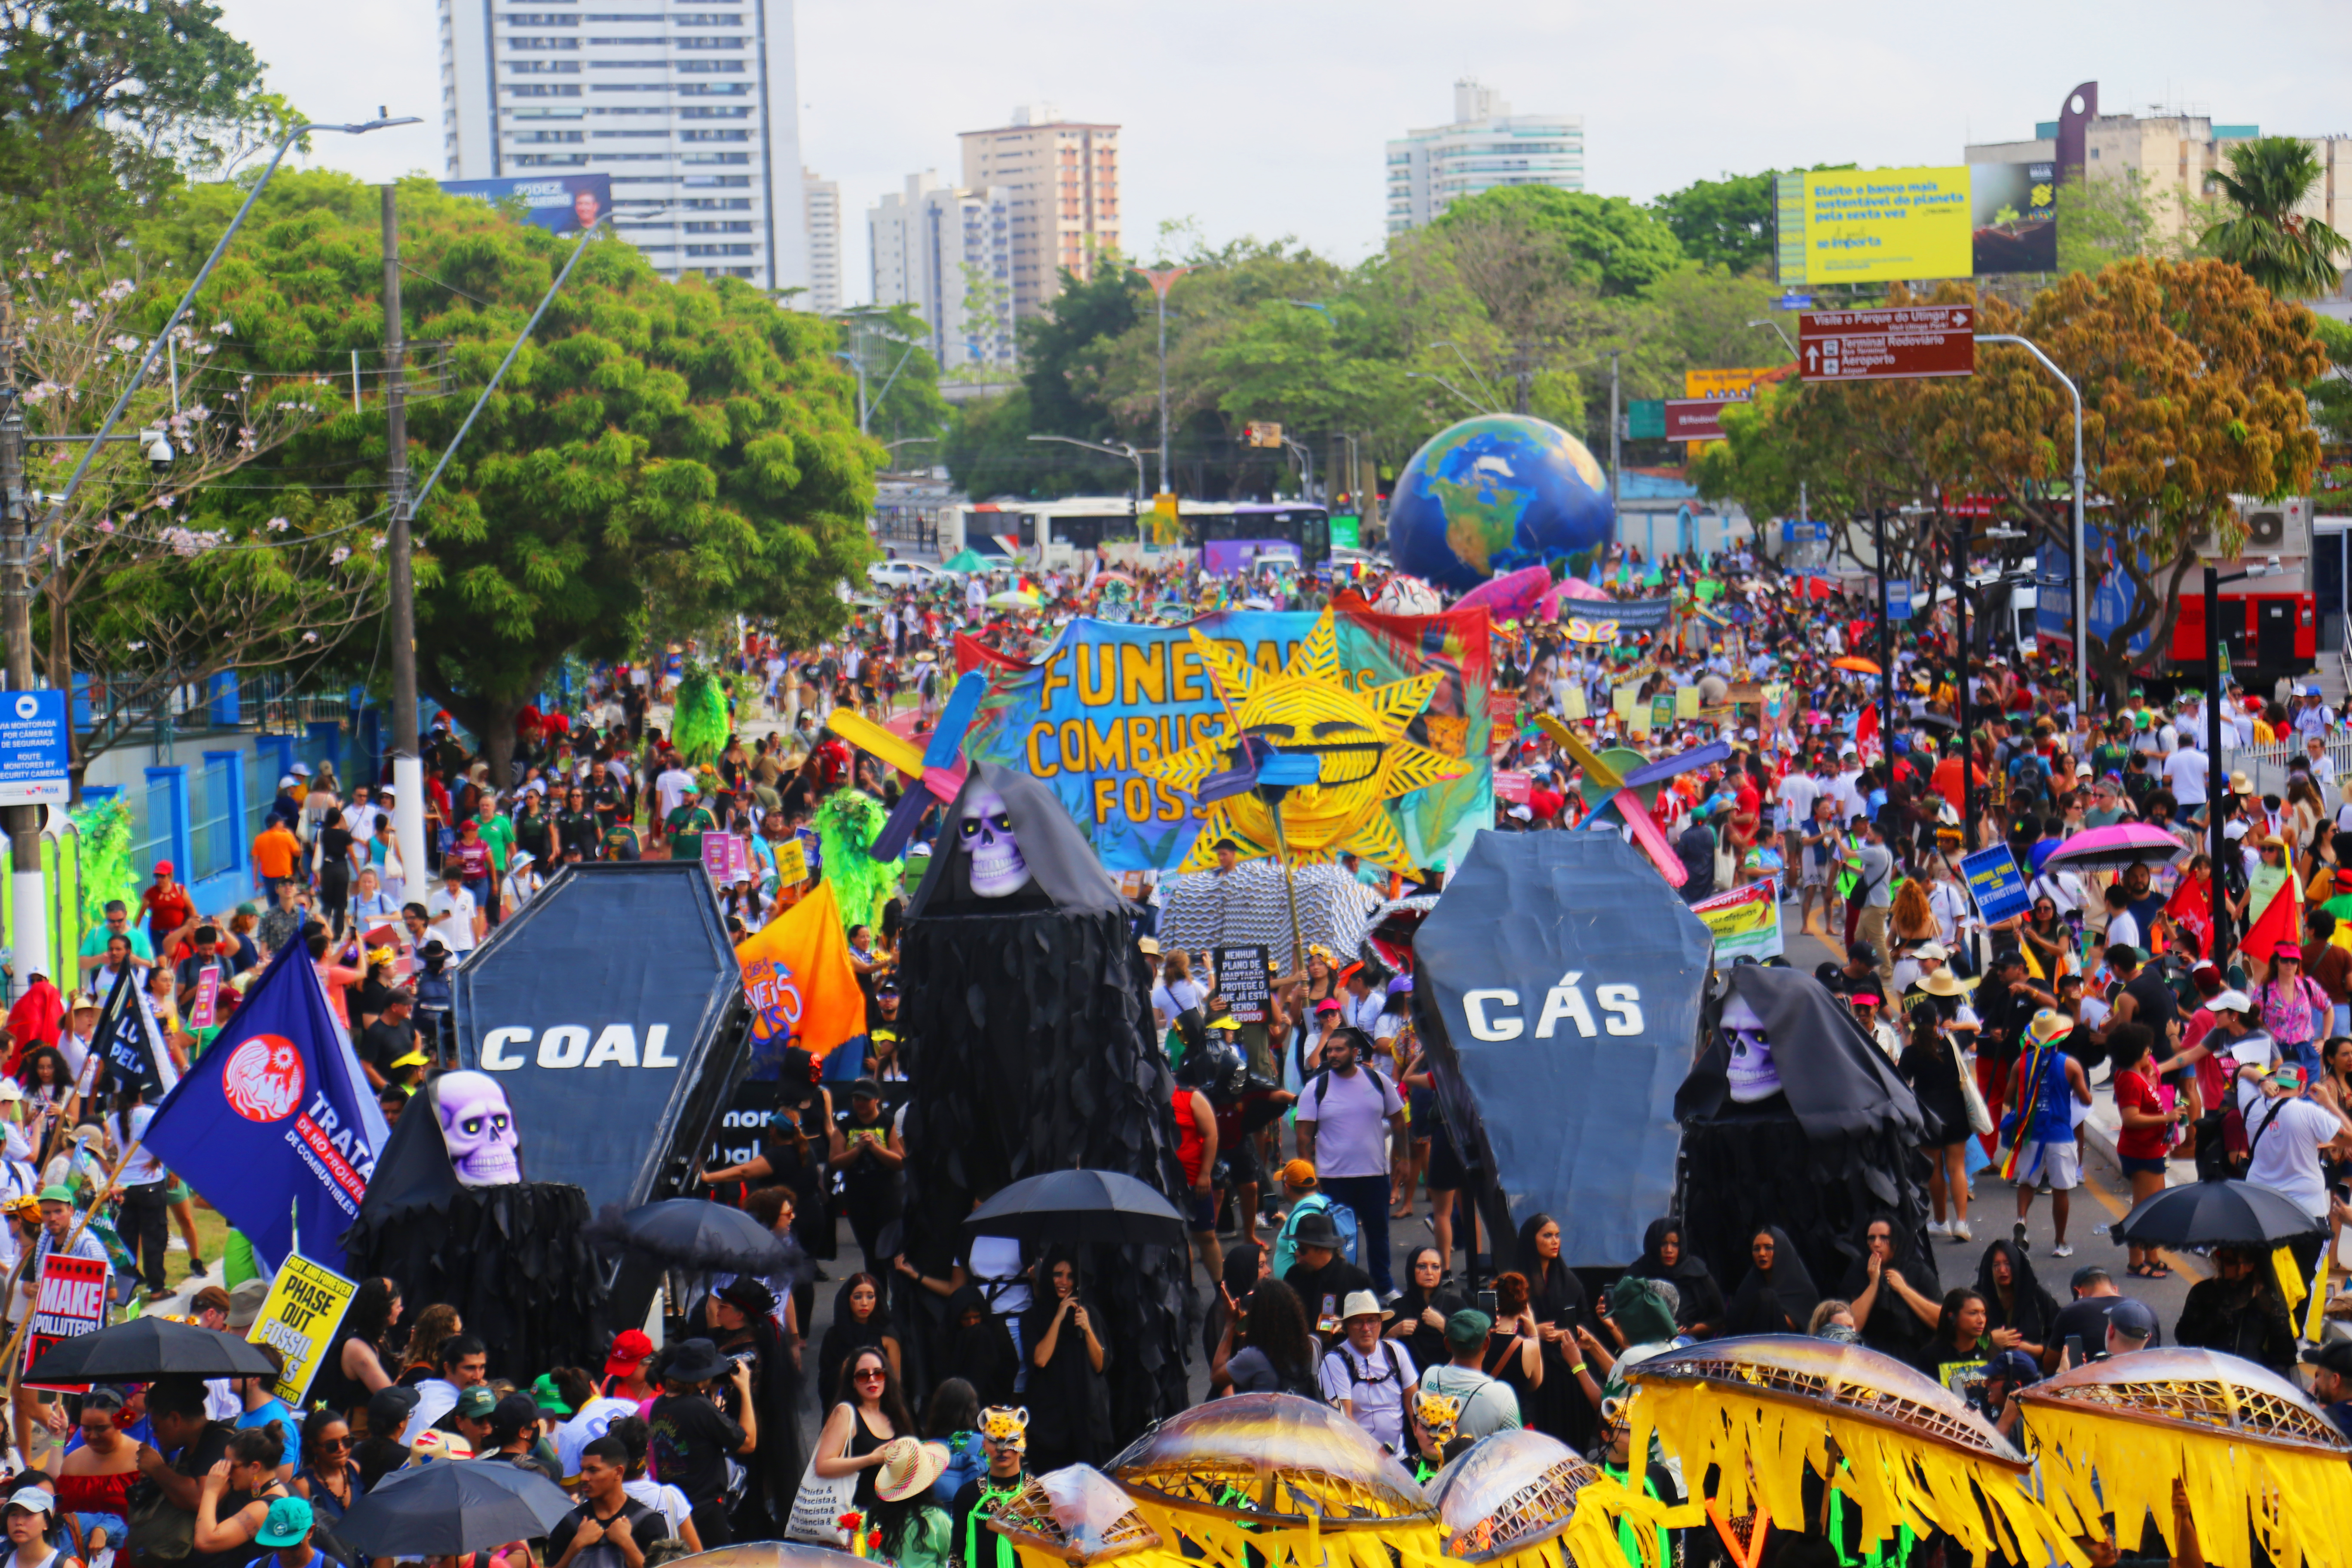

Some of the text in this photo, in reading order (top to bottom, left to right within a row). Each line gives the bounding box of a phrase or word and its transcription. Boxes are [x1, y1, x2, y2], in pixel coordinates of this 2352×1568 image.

[1815, 181, 1938, 197] Eleito o banco mais
[1816, 193, 1964, 209] sustentável do planeta
[1815, 209, 1906, 224] pela sexta vez
[1817, 236, 1881, 250] se importa
[1813, 309, 1949, 326] Visite o Parque do Utinga!
[1841, 334, 1945, 348] Terminal Rodoviário
[1841, 354, 1895, 367] Aeroporto
[11, 720, 56, 729] MONITORADA
[19, 730, 53, 738] CÂMERAS
[12, 738, 55, 748] SEGURANÇA
[3, 761, 44, 770] MONITORED
[0, 769, 64, 780] ECURITY CAMERAS
[1969, 861, 2015, 887] FOSSIL FREE
[1978, 882, 2023, 907] EXTINCTION
[1224, 950, 1257, 960] NENHUM
[1222, 960, 1261, 971] PLANO DE
[1220, 969, 1265, 981] ADAPTAÇÃO
[1221, 980, 1265, 992] PROTEGE O
[1219, 989, 1268, 1002] QUE JÁ ESTÁ
[1231, 1002, 1258, 1012] SENDO
[1462, 969, 1645, 1042] GÁS
[480, 1023, 680, 1071] COAL
[297, 1118, 312, 1136] DE
[309, 1133, 329, 1153] NO
[284, 1129, 356, 1216] DE COMBUSTIBLES
[287, 1255, 355, 1298] FAST AND FOREVER
[37, 1277, 102, 1318] MAKE
[282, 1274, 336, 1317] PHASE
[280, 1302, 315, 1332] OUT
[33, 1314, 98, 1337] POLLUTERS
[257, 1318, 313, 1363] FOSSIL
[826, 1486, 832, 1494] &
